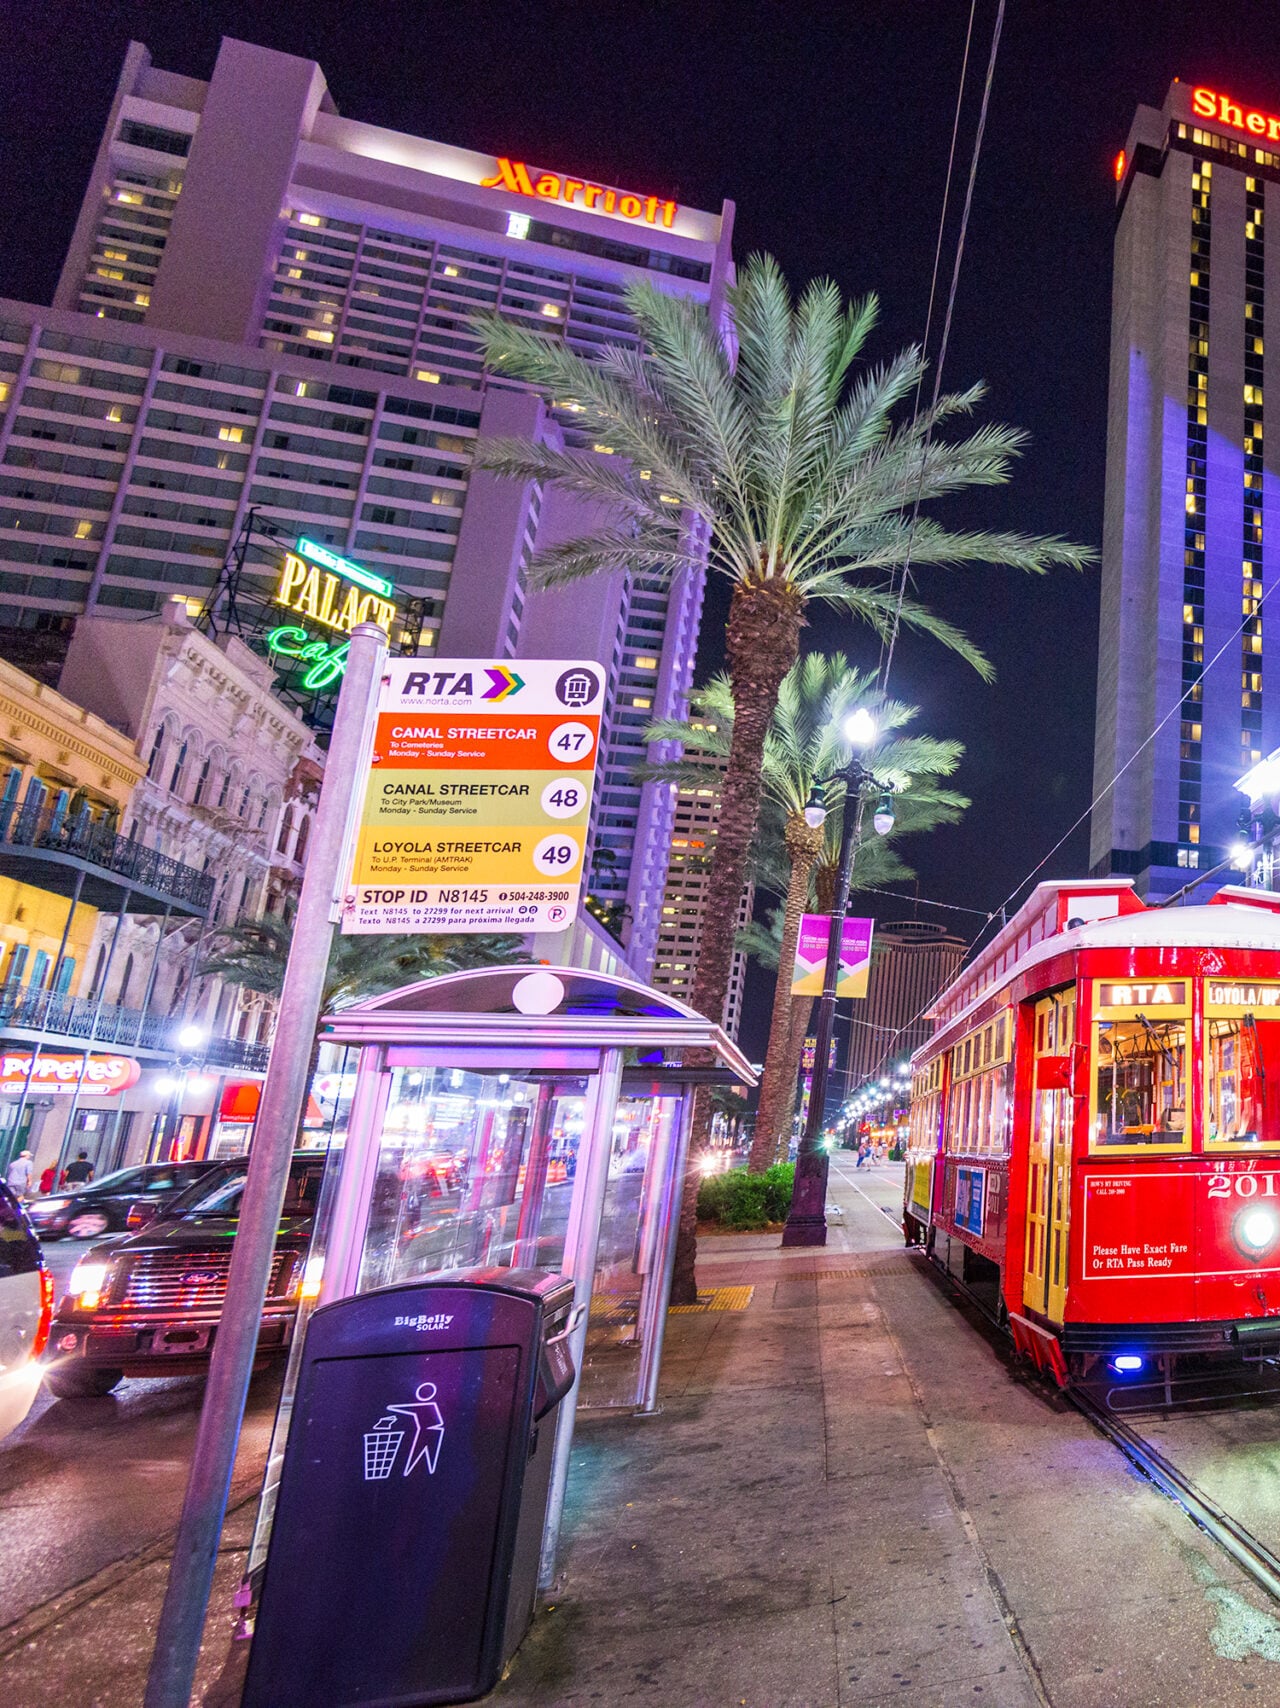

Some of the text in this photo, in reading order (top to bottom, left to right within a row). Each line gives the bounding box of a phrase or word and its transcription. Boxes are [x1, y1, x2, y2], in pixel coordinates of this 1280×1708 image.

[480, 157, 677, 228] Marriott
[268, 626, 351, 689] Caf
[402, 673, 473, 695] RTA
[400, 698, 472, 706] www.norta.com
[392, 728, 536, 739] CANAL STREETCAR
[558, 734, 585, 750] 47
[389, 750, 418, 758] Monday
[383, 784, 529, 795] CANAL STREETCAR
[550, 789, 578, 806] 48
[419, 807, 448, 815] Sunday
[374, 842, 521, 853] LOYOLA STREETCAR
[542, 846, 571, 864] 49
[370, 865, 401, 873] Monday
[409, 865, 439, 873] Sunday
[363, 890, 569, 903] STOP ID N8145 504-248-3900
[469, 917, 501, 926] próxima
[504, 916, 535, 925] llegada
[1112, 984, 1173, 1005] RTA
[1093, 1243, 1187, 1255] Please Have Exact Fare
[1093, 1257, 1172, 1269] Or RTA Pass Ready
[394, 1314, 454, 1326] BigBelly
[416, 1323, 444, 1331] SOLAR
